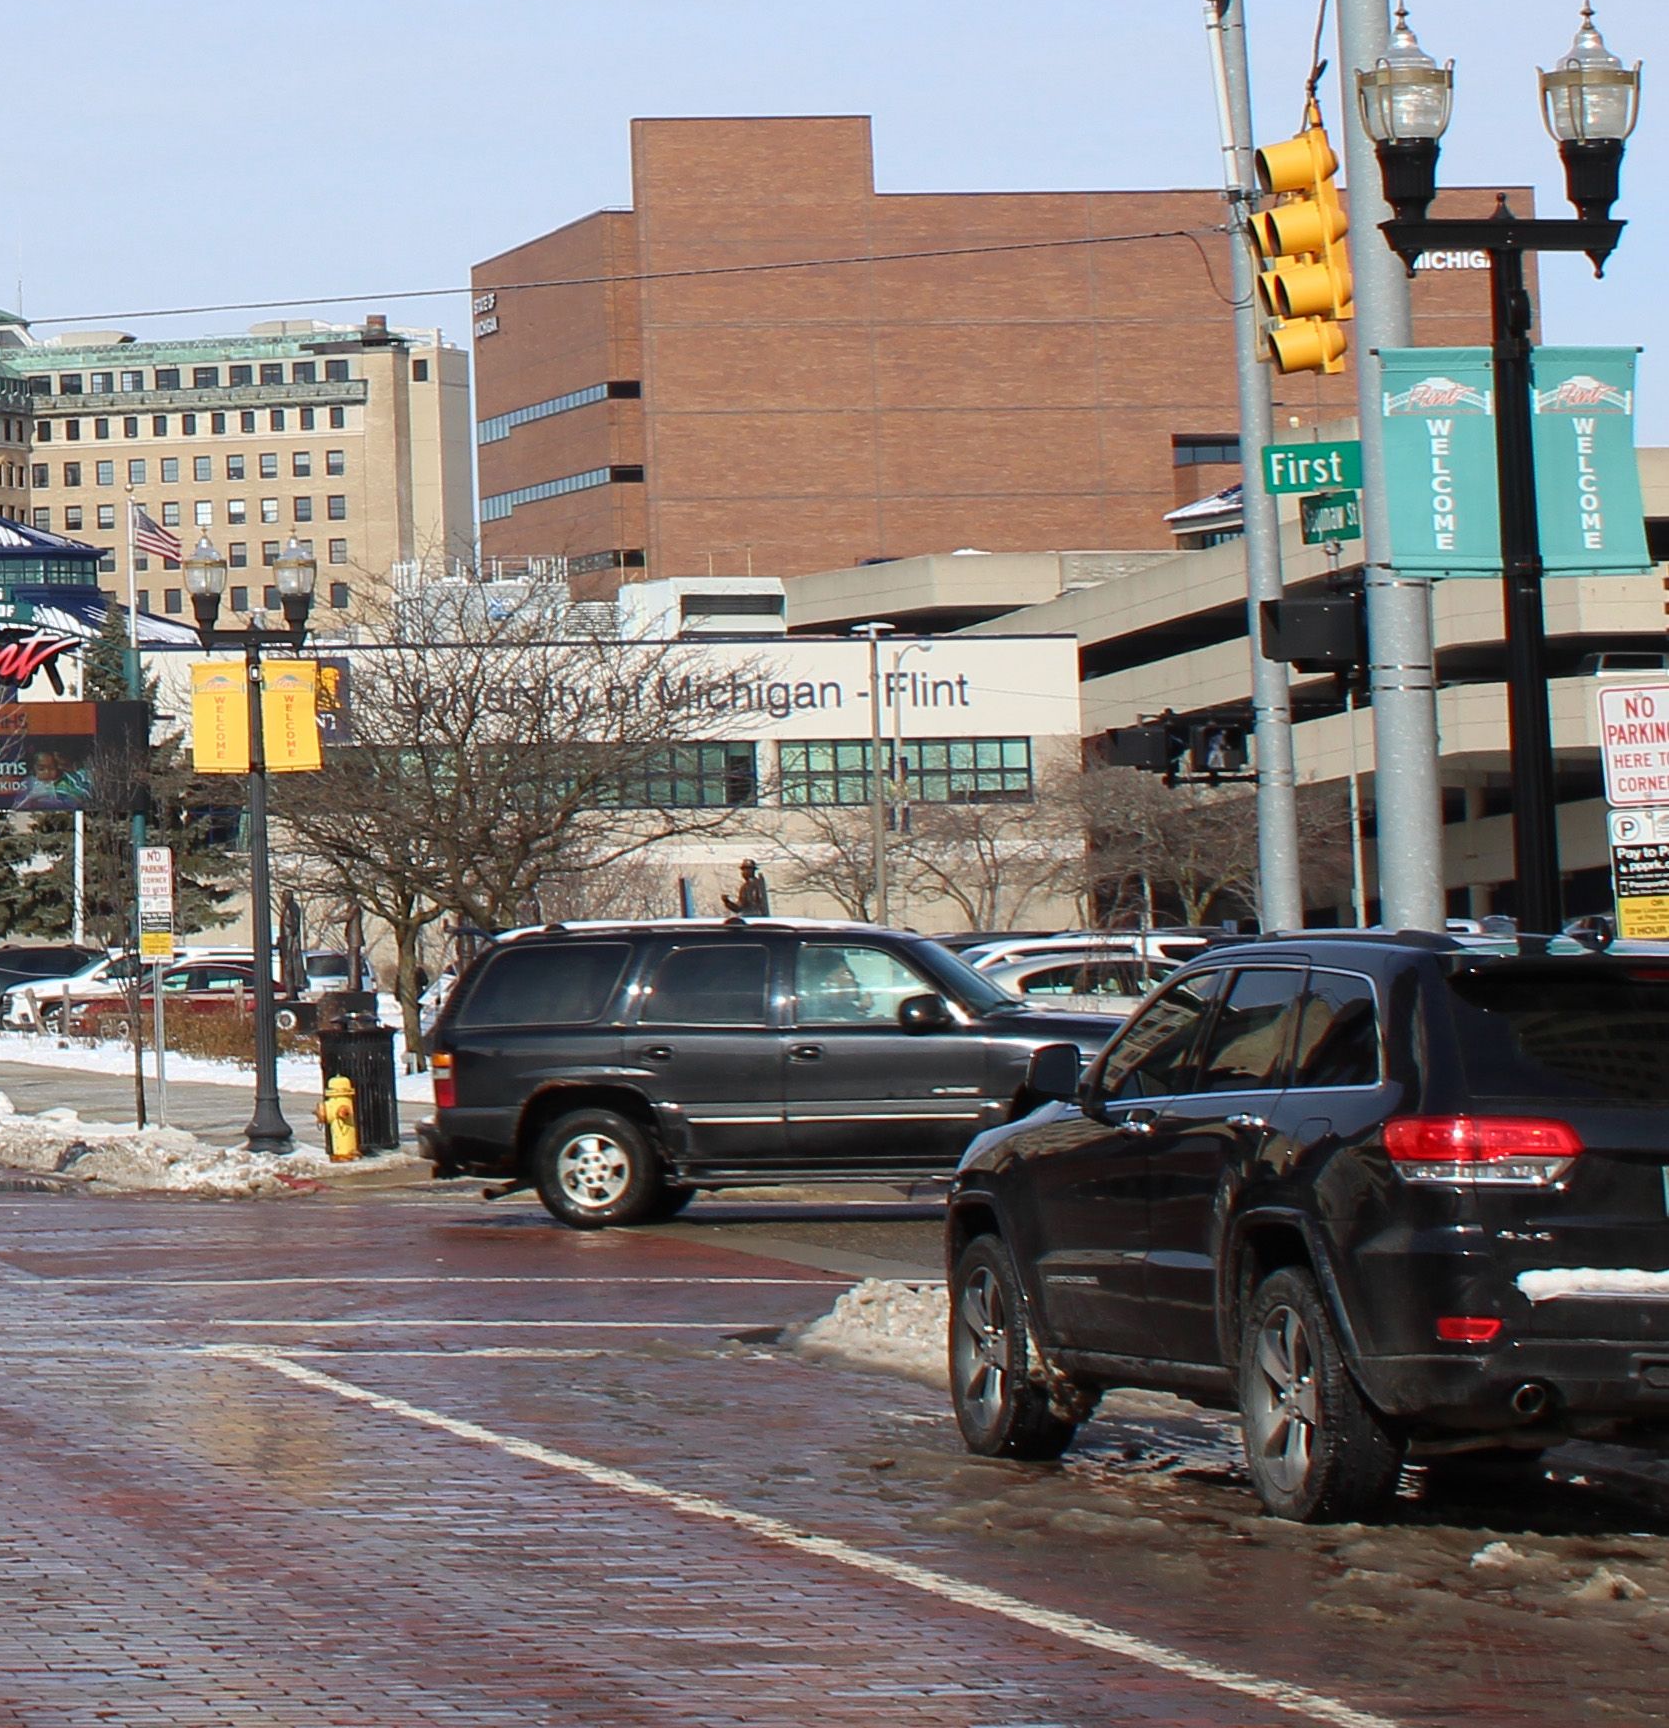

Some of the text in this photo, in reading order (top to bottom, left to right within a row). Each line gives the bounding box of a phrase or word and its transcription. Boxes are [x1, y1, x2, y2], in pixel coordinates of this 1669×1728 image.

[1270, 451, 1343, 486] First
[1426, 418, 1455, 550] WELCOME
[1572, 418, 1603, 549] WELCOME
[659, 673, 842, 719] Michigan
[885, 672, 969, 707] Flint
[1624, 696, 1654, 719] NO
[214, 696, 227, 759] WELCOME
[284, 695, 295, 758] WELCOME
[1607, 722, 1669, 746] PARKIN
[1614, 752, 1653, 769] HERE
[1618, 775, 1669, 792] CORNE
[1616, 847, 1642, 861] Pay
[1643, 847, 1657, 858] to
[1637, 925, 1666, 936] HOUR
